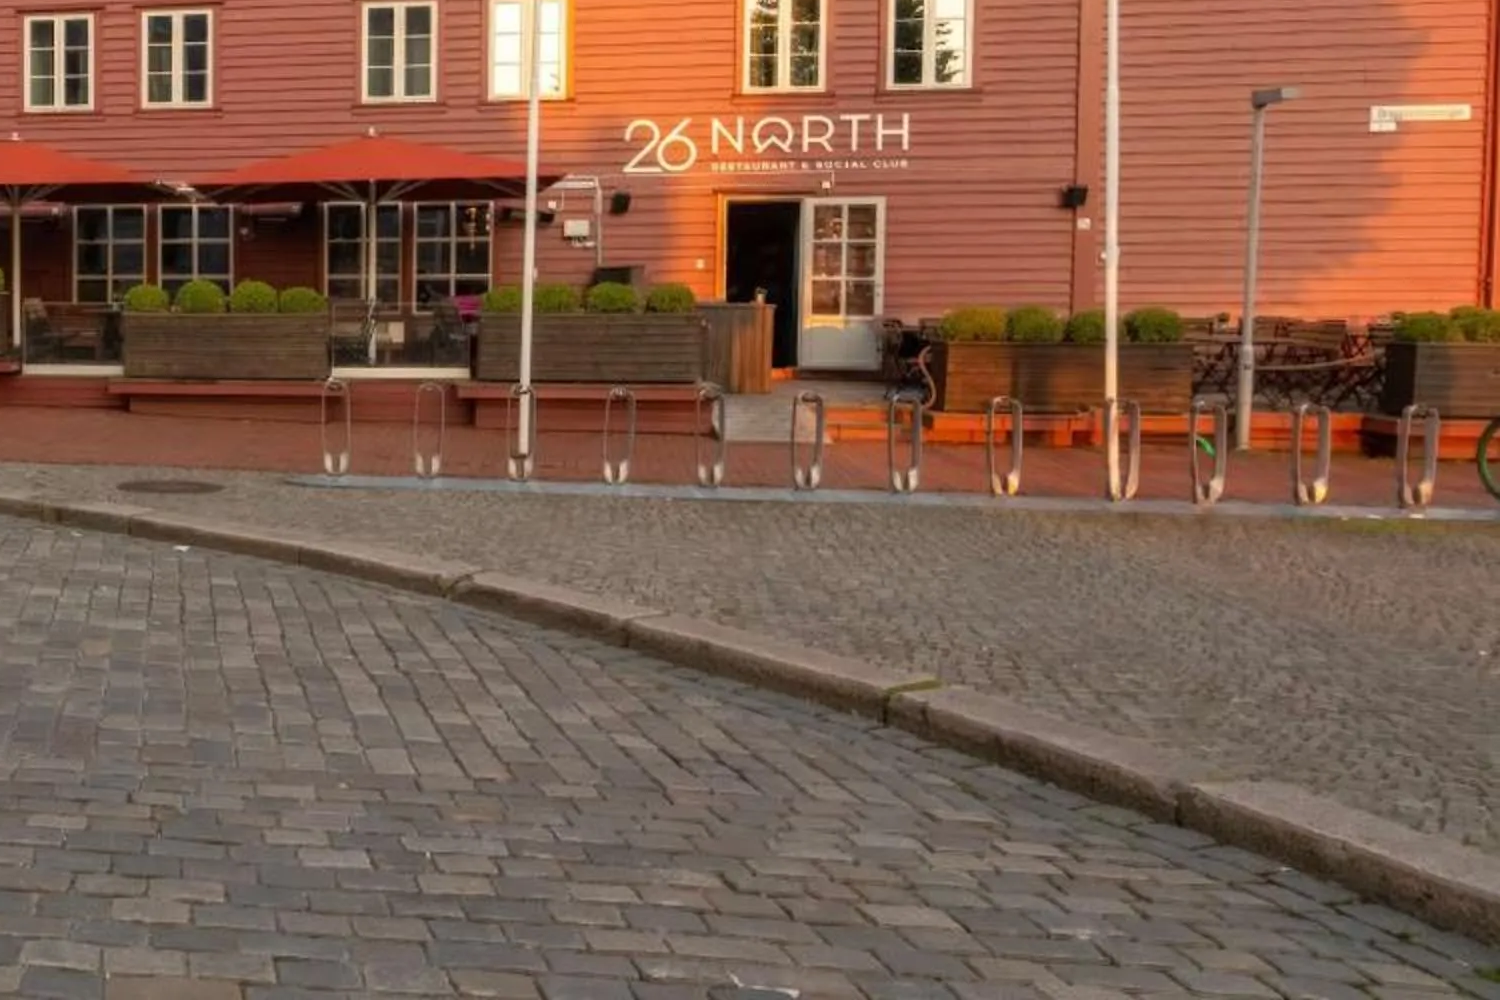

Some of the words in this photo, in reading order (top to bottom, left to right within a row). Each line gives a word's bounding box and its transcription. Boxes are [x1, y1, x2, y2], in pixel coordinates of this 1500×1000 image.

[623, 118, 697, 172] 26
[711, 113, 909, 154] NORTH
[816, 160, 867, 169] SOCIAL
[873, 159, 908, 168] CLUB
